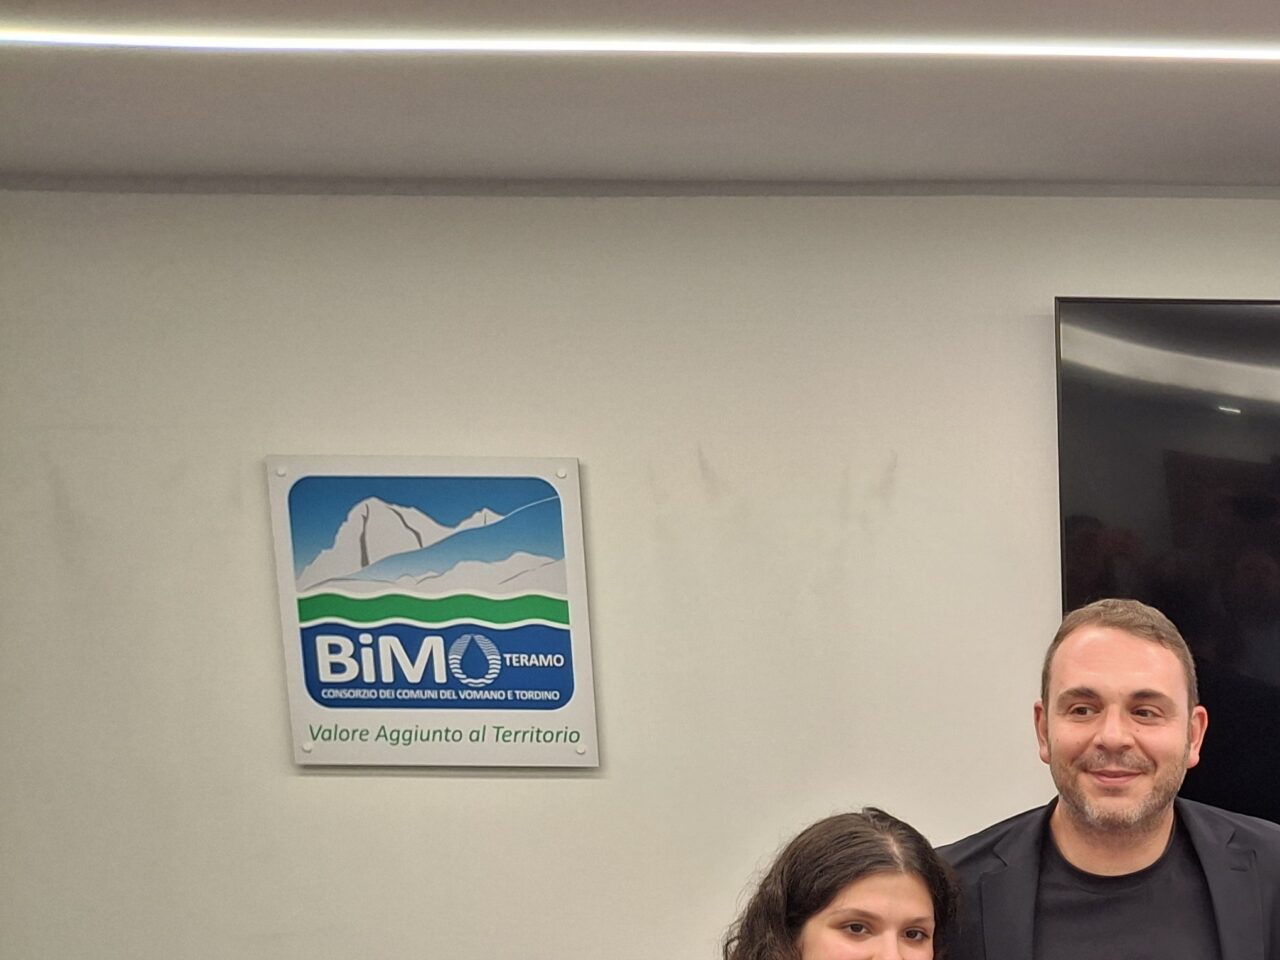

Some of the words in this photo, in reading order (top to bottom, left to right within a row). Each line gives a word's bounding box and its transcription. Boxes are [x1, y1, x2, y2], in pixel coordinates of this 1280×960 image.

[503, 654, 564, 668] TERAMO
[321, 689, 377, 700] CONSORZIO
[379, 689, 395, 700] DEI
[396, 689, 438, 700] COMUNI
[440, 690, 458, 700] DEL
[457, 690, 506, 701] VOMANO
[515, 690, 560, 701] TORDINO
[309, 724, 370, 742] Valore
[375, 725, 463, 746] Aggiunto
[469, 725, 486, 743] al
[493, 725, 580, 744] Territorio
